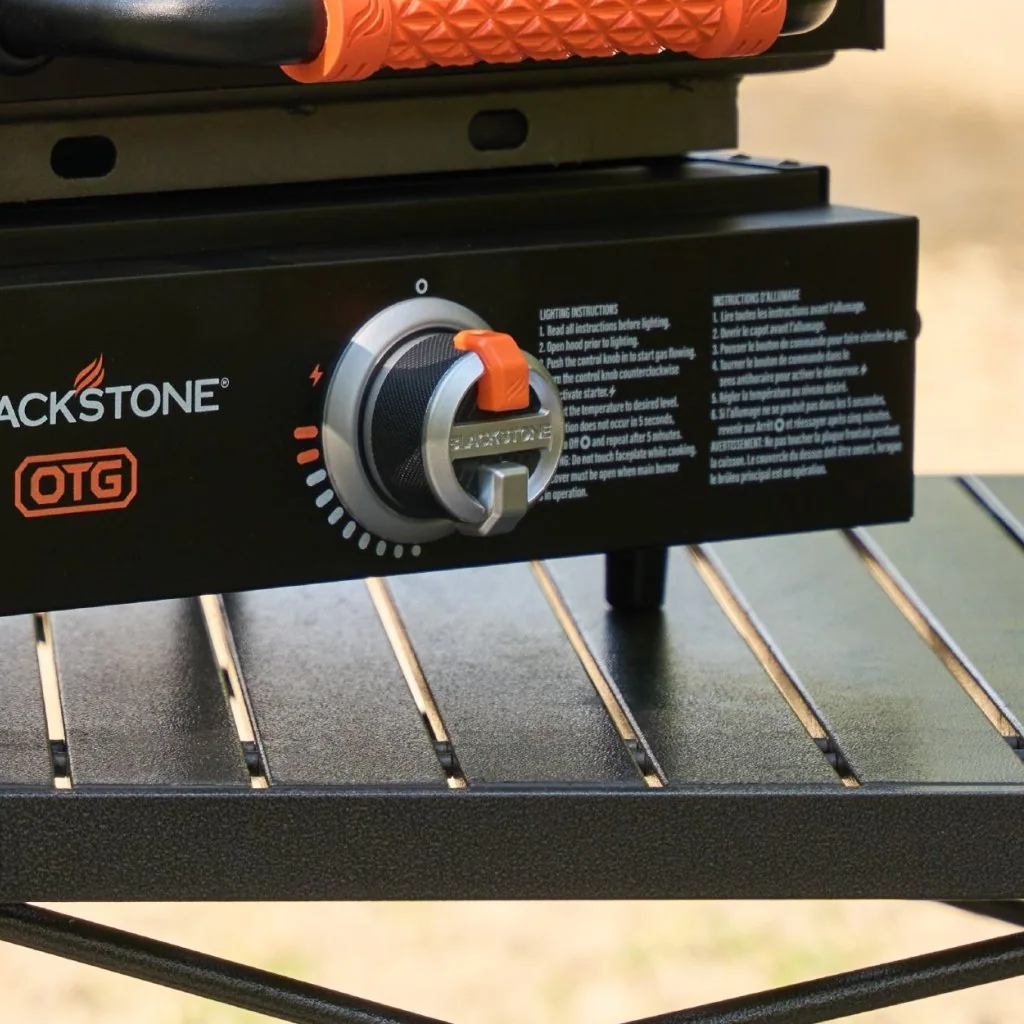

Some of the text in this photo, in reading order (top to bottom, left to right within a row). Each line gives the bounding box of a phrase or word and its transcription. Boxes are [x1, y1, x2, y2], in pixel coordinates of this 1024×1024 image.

[539, 304, 618, 320] LIGHTING INSTRUCTIONS
[539, 317, 671, 336] 1. Read all instructions before lighting.
[539, 336, 639, 354] 2. Open hood prior to lighting.
[546, 357, 564, 370] Push
[565, 357, 576, 367] the
[577, 354, 602, 366] control
[603, 352, 620, 364] knob
[621, 352, 628, 362] in
[629, 352, 636, 362] to
[637, 350, 654, 361] start
[655, 350, 668, 362] gas
[668, 347, 696, 360] flowing.
[562, 373, 574, 384] the
[575, 370, 601, 383] control
[601, 369, 618, 380] knob
[619, 364, 680, 379] counterclockwise
[569, 405, 581, 416] the
[581, 402, 624, 416] temperature
[625, 401, 632, 411] to
[633, 398, 659, 411] desired
[660, 396, 679, 408] level.
[580, 421, 597, 431] does
[597, 419, 609, 430] not
[610, 419, 629, 429] occur
[630, 416, 638, 427] in
[638, 416, 643, 427] 5
[569, 437, 579, 449] Off
[591, 435, 605, 447] and
[606, 434, 629, 447] repeat
[629, 432, 646, 443] after
[646, 431, 651, 442] 5
[572, 454, 581, 465] Do
[582, 454, 594, 464] not
[595, 451, 614, 463] touch
[648, 446, 667, 458] while
[570, 470, 588, 481] must
[589, 469, 598, 480] be
[599, 469, 616, 481] open
[617, 466, 636, 477] when
[637, 464, 654, 475] main
[655, 463, 680, 474] burner
[30, 459, 123, 505] OTG
[544, 489, 552, 500] in
